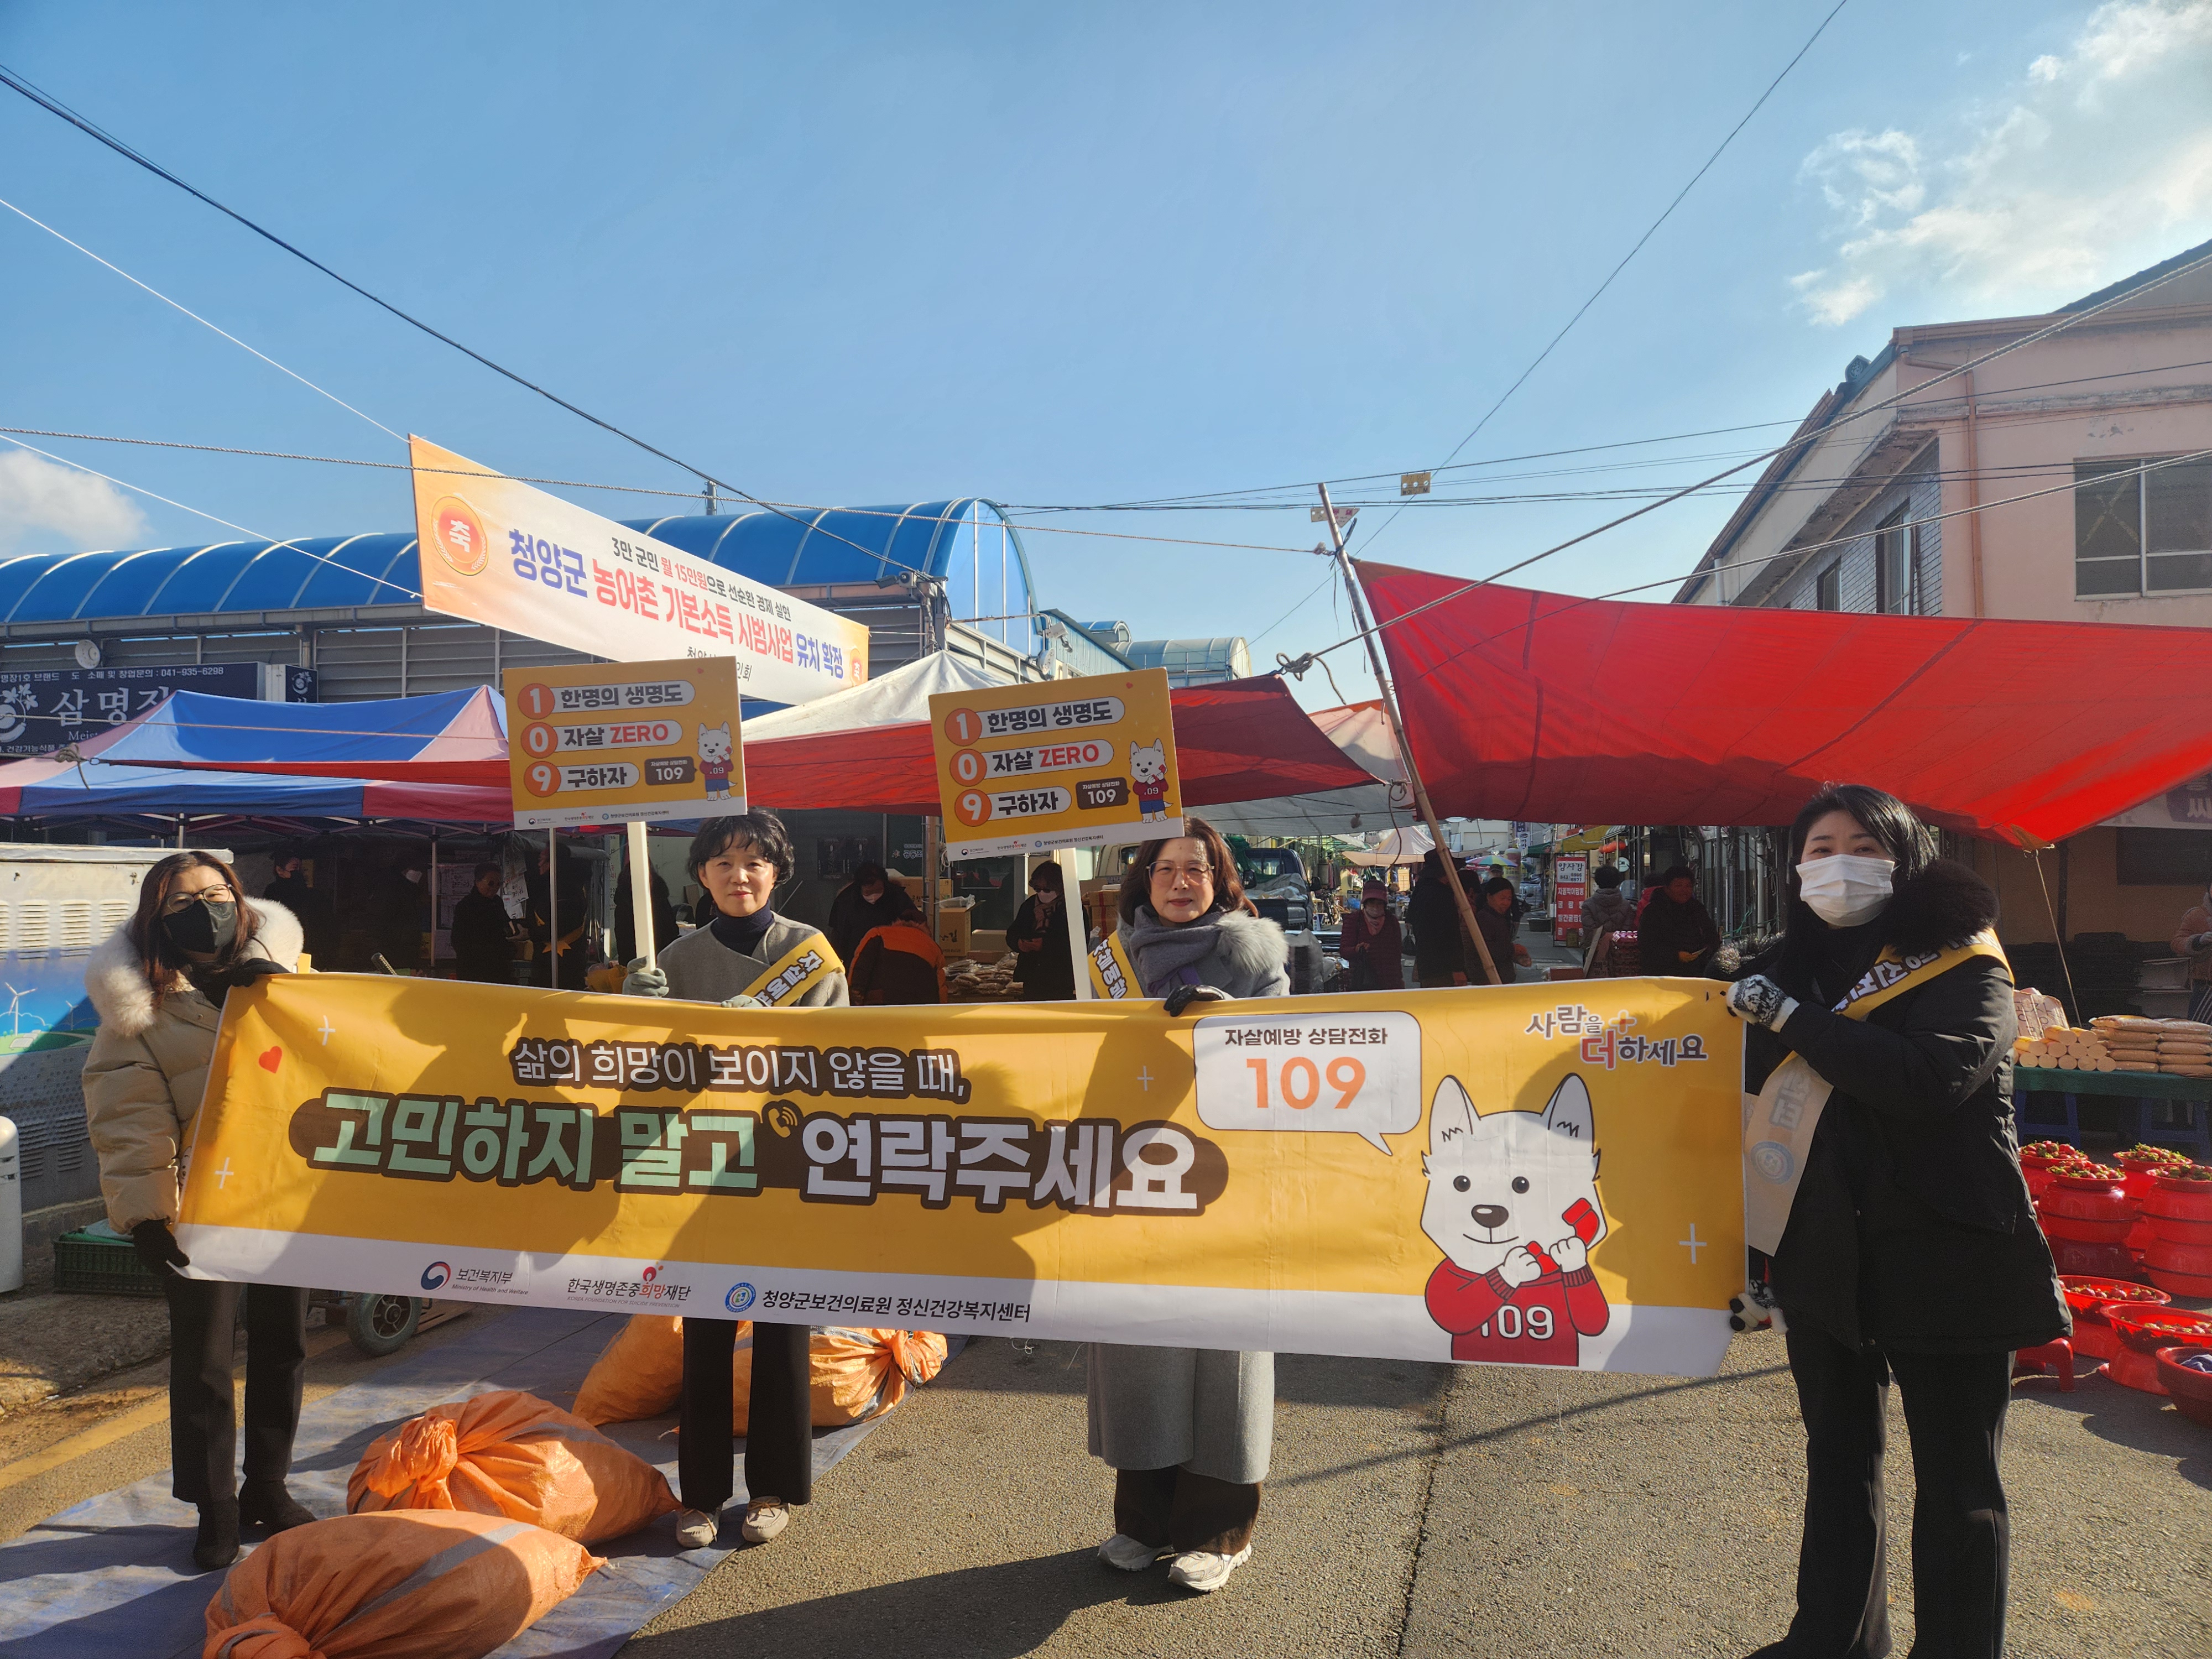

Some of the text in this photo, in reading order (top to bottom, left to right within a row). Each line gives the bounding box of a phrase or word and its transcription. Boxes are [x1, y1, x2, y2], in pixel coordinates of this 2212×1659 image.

[448, 519, 471, 552] 축
[612, 537, 791, 622] 3만 군민 월 15만원으로 선순환 경제 실현
[509, 529, 844, 679] 청양군 농어촌 기본소득 시범사업 유치 확정
[34, 672, 60, 681] 브랜드
[88, 671, 105, 680] 소매
[119, 670, 154, 678] 창업문의
[161, 667, 223, 677] 041-935-6298
[530, 685, 683, 713] 1 한명의 생명도
[956, 701, 1112, 740] 1 한명의 생명도
[529, 724, 669, 753] 0 자살 ZERO
[656, 767, 683, 780] 109
[958, 744, 1099, 780] 0 자살 ZERO
[532, 765, 627, 791] 9 구하자
[1144, 787, 1159, 795] 09
[962, 791, 1058, 820] 9 구하자
[1088, 789, 1116, 804] 109
[1559, 863, 1584, 872] 양자강
[1525, 1005, 1604, 1039] 사람을
[1225, 1028, 1388, 1046] 자살예방 상담전화
[1581, 1030, 1707, 1070] 더하세요
[517, 1043, 966, 1098] 삶의 희망이 보이지 않을 때,
[1246, 1057, 1366, 1110] 109
[314, 1094, 1198, 1209] 고민하지 말고 연락주세요
[456, 1269, 513, 1285] 보건복지부
[567, 1278, 691, 1301] 한국생명존중희망재단
[763, 1290, 892, 1315] 청양군보건의료원
[895, 1297, 1031, 1323] 정신건강복지센터
